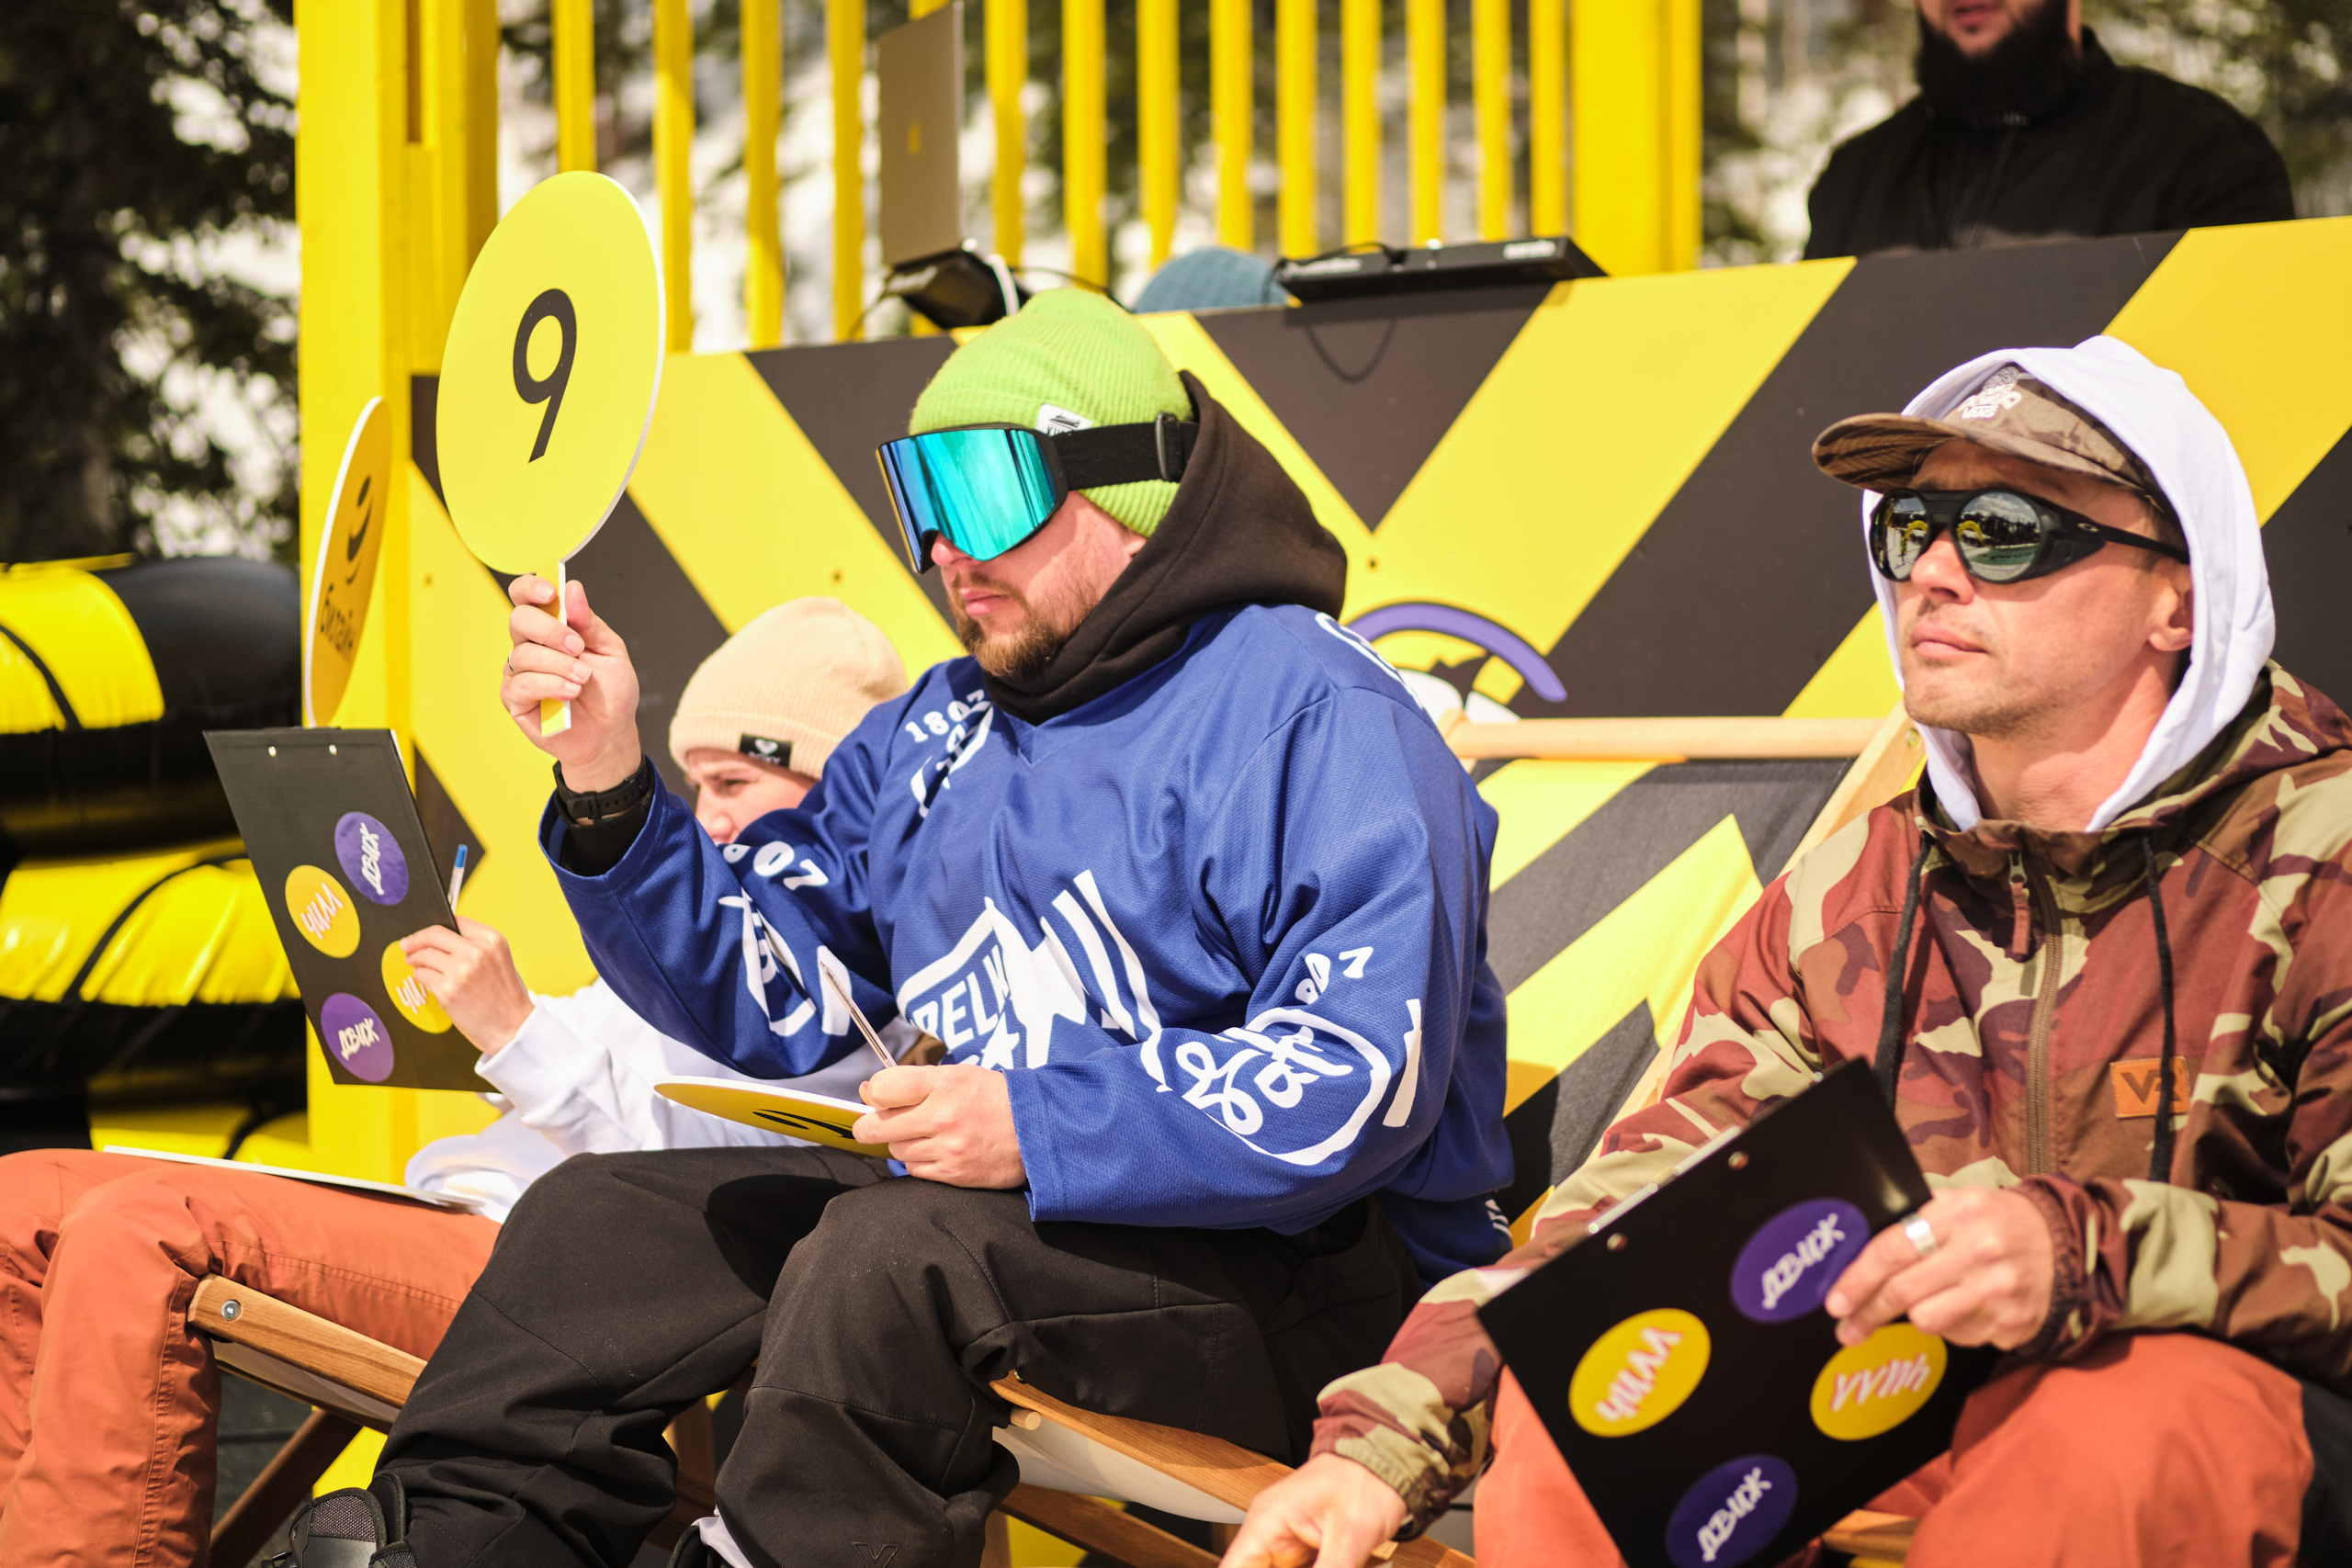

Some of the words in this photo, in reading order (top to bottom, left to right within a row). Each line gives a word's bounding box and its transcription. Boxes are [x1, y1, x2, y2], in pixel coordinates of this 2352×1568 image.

[513, 288, 577, 464] 9
[337, 1017, 380, 1061] ДВИЖ
[1762, 1213, 1845, 1310] ДВИЖ
[1697, 1467, 1772, 1562] ДВИЖ
